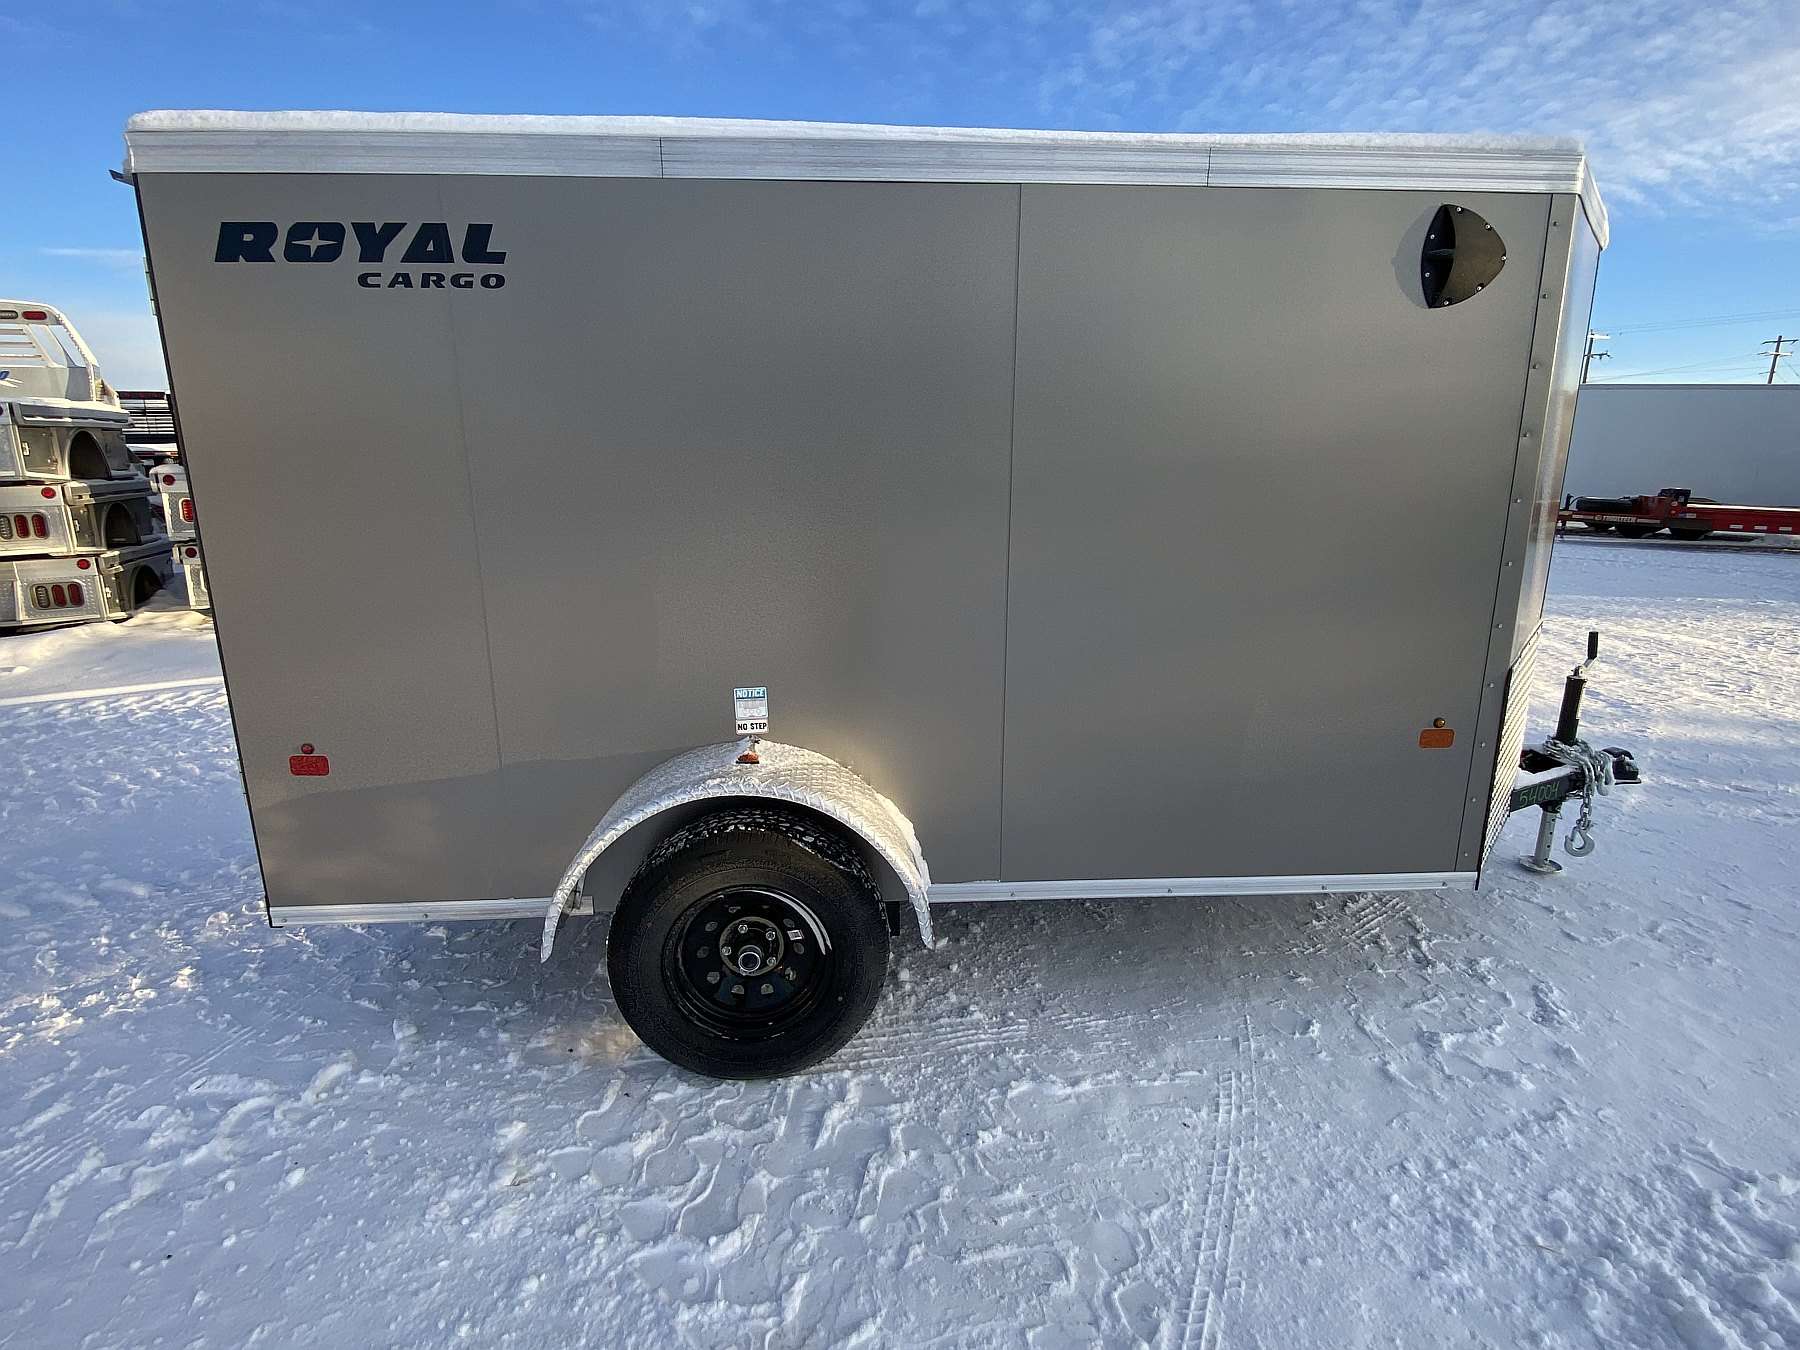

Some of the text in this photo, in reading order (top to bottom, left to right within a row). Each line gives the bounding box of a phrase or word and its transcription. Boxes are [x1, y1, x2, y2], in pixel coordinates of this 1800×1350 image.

[215, 222, 507, 264] ROYAL
[357, 272, 506, 289] CARGO
[736, 689, 765, 698] NOTICE
[750, 722, 767, 730] STEP
[1519, 781, 1560, 808] 54004
